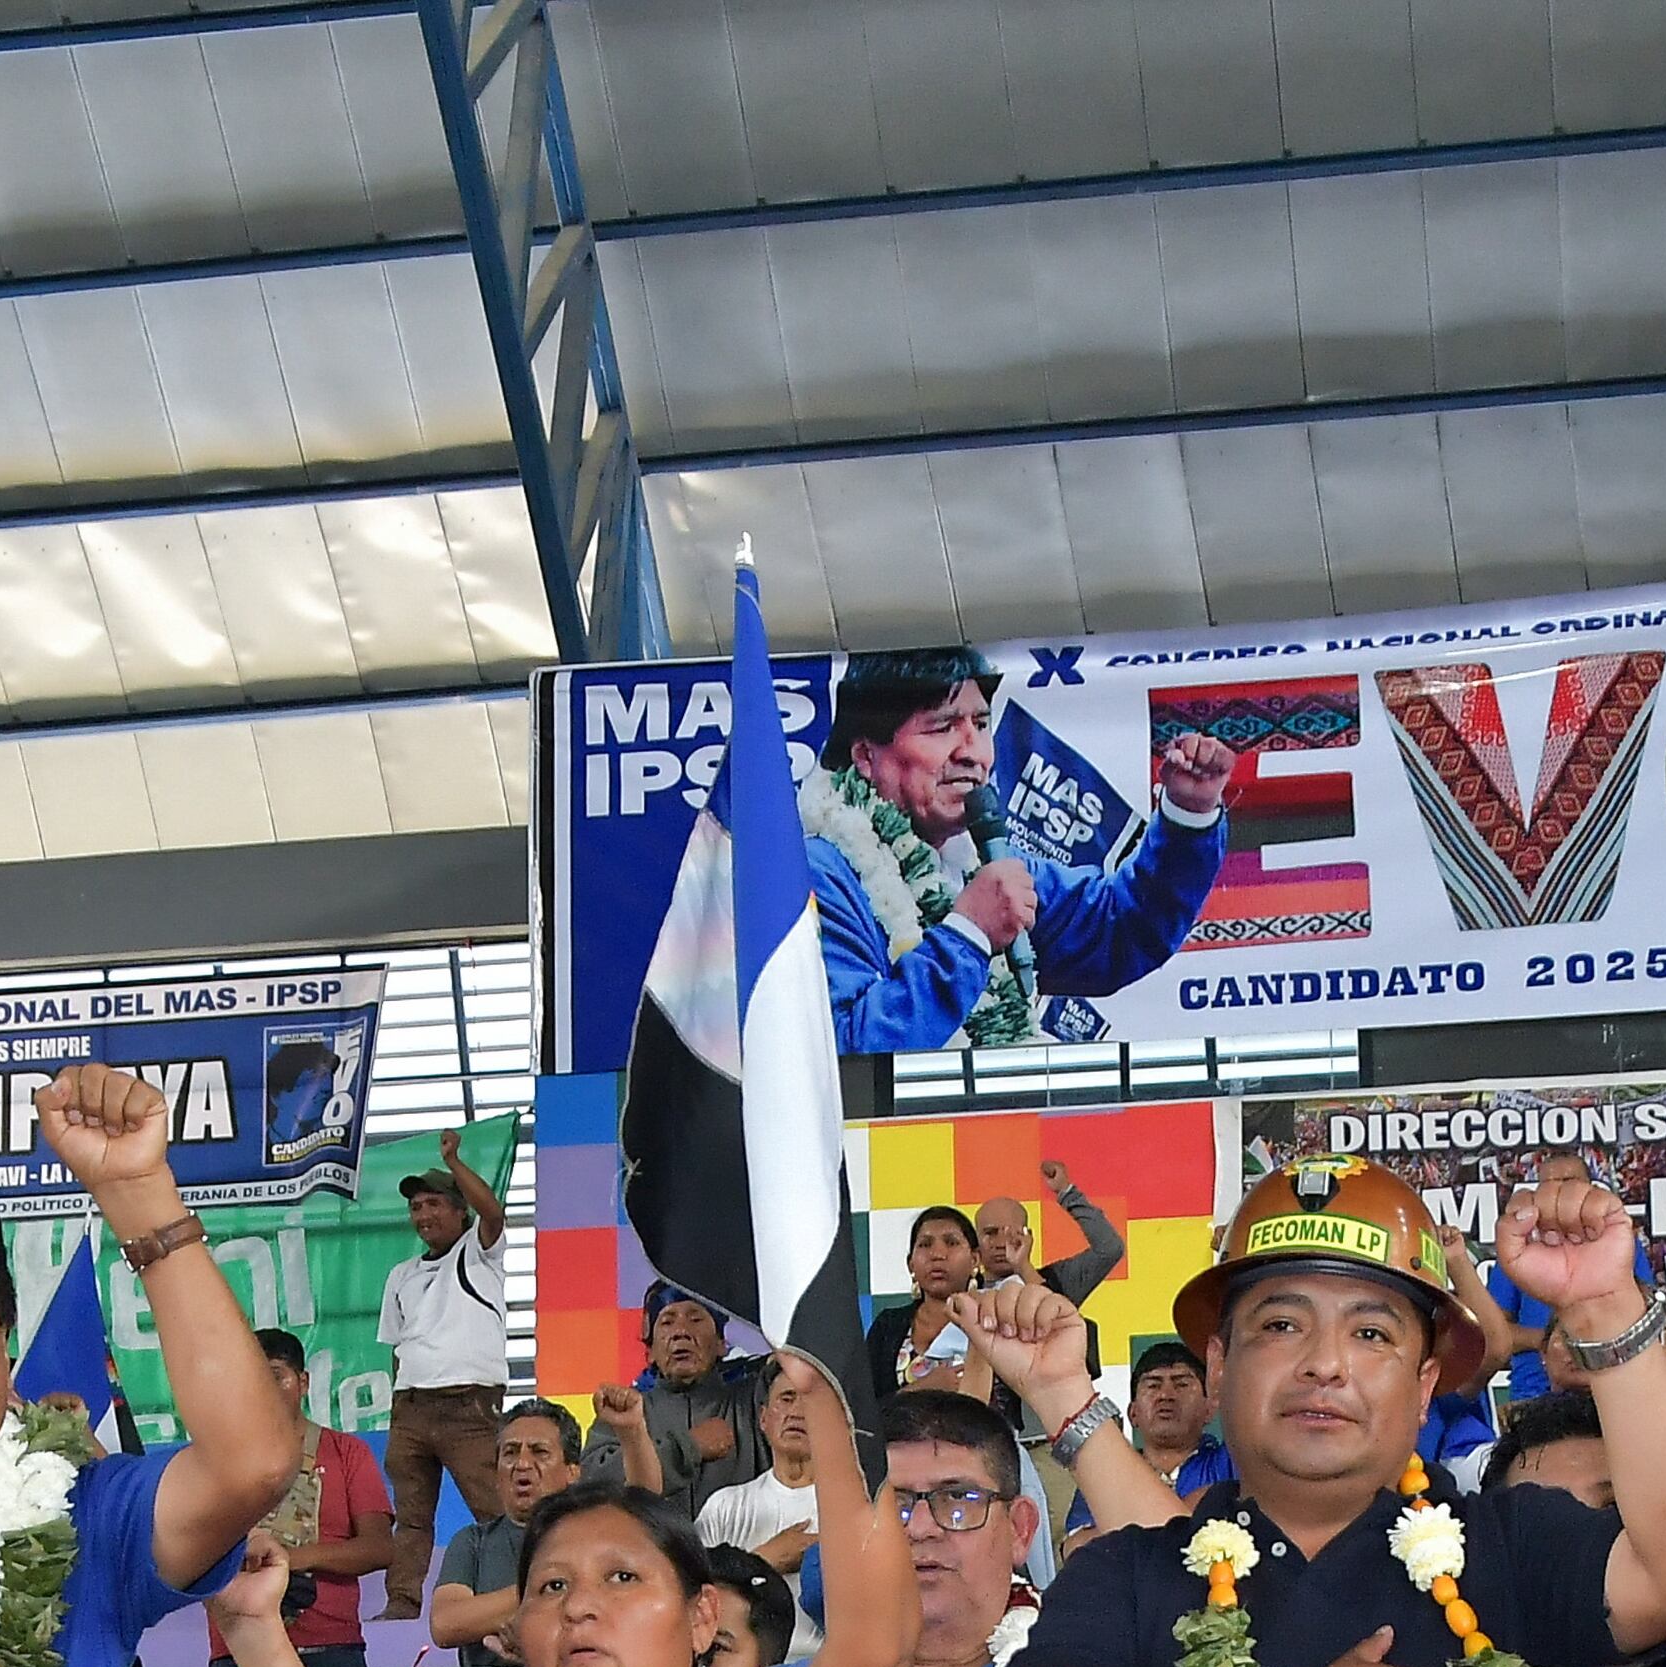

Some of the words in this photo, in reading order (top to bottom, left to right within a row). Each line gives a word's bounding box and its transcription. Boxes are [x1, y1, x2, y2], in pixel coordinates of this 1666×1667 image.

[1028, 646, 1085, 688] X
[585, 678, 816, 746] MAS
[1021, 752, 1104, 825] MAS
[1007, 781, 1094, 848] IPSP
[90, 990, 154, 1020] DEL
[162, 985, 237, 1016] MAS
[266, 978, 343, 1010] IPSP
[1179, 958, 1485, 1011] CANDIDATO
[12, 1034, 91, 1062] SIEMPRE
[1330, 1102, 1617, 1153] DIRECCION
[11, 1198, 83, 1213] POLÍTICO
[243, 1186, 262, 1198] DE
[268, 1182, 296, 1196] LOS
[1251, 1217, 1346, 1249] FECOMAN
[1356, 1227, 1381, 1252] LP
